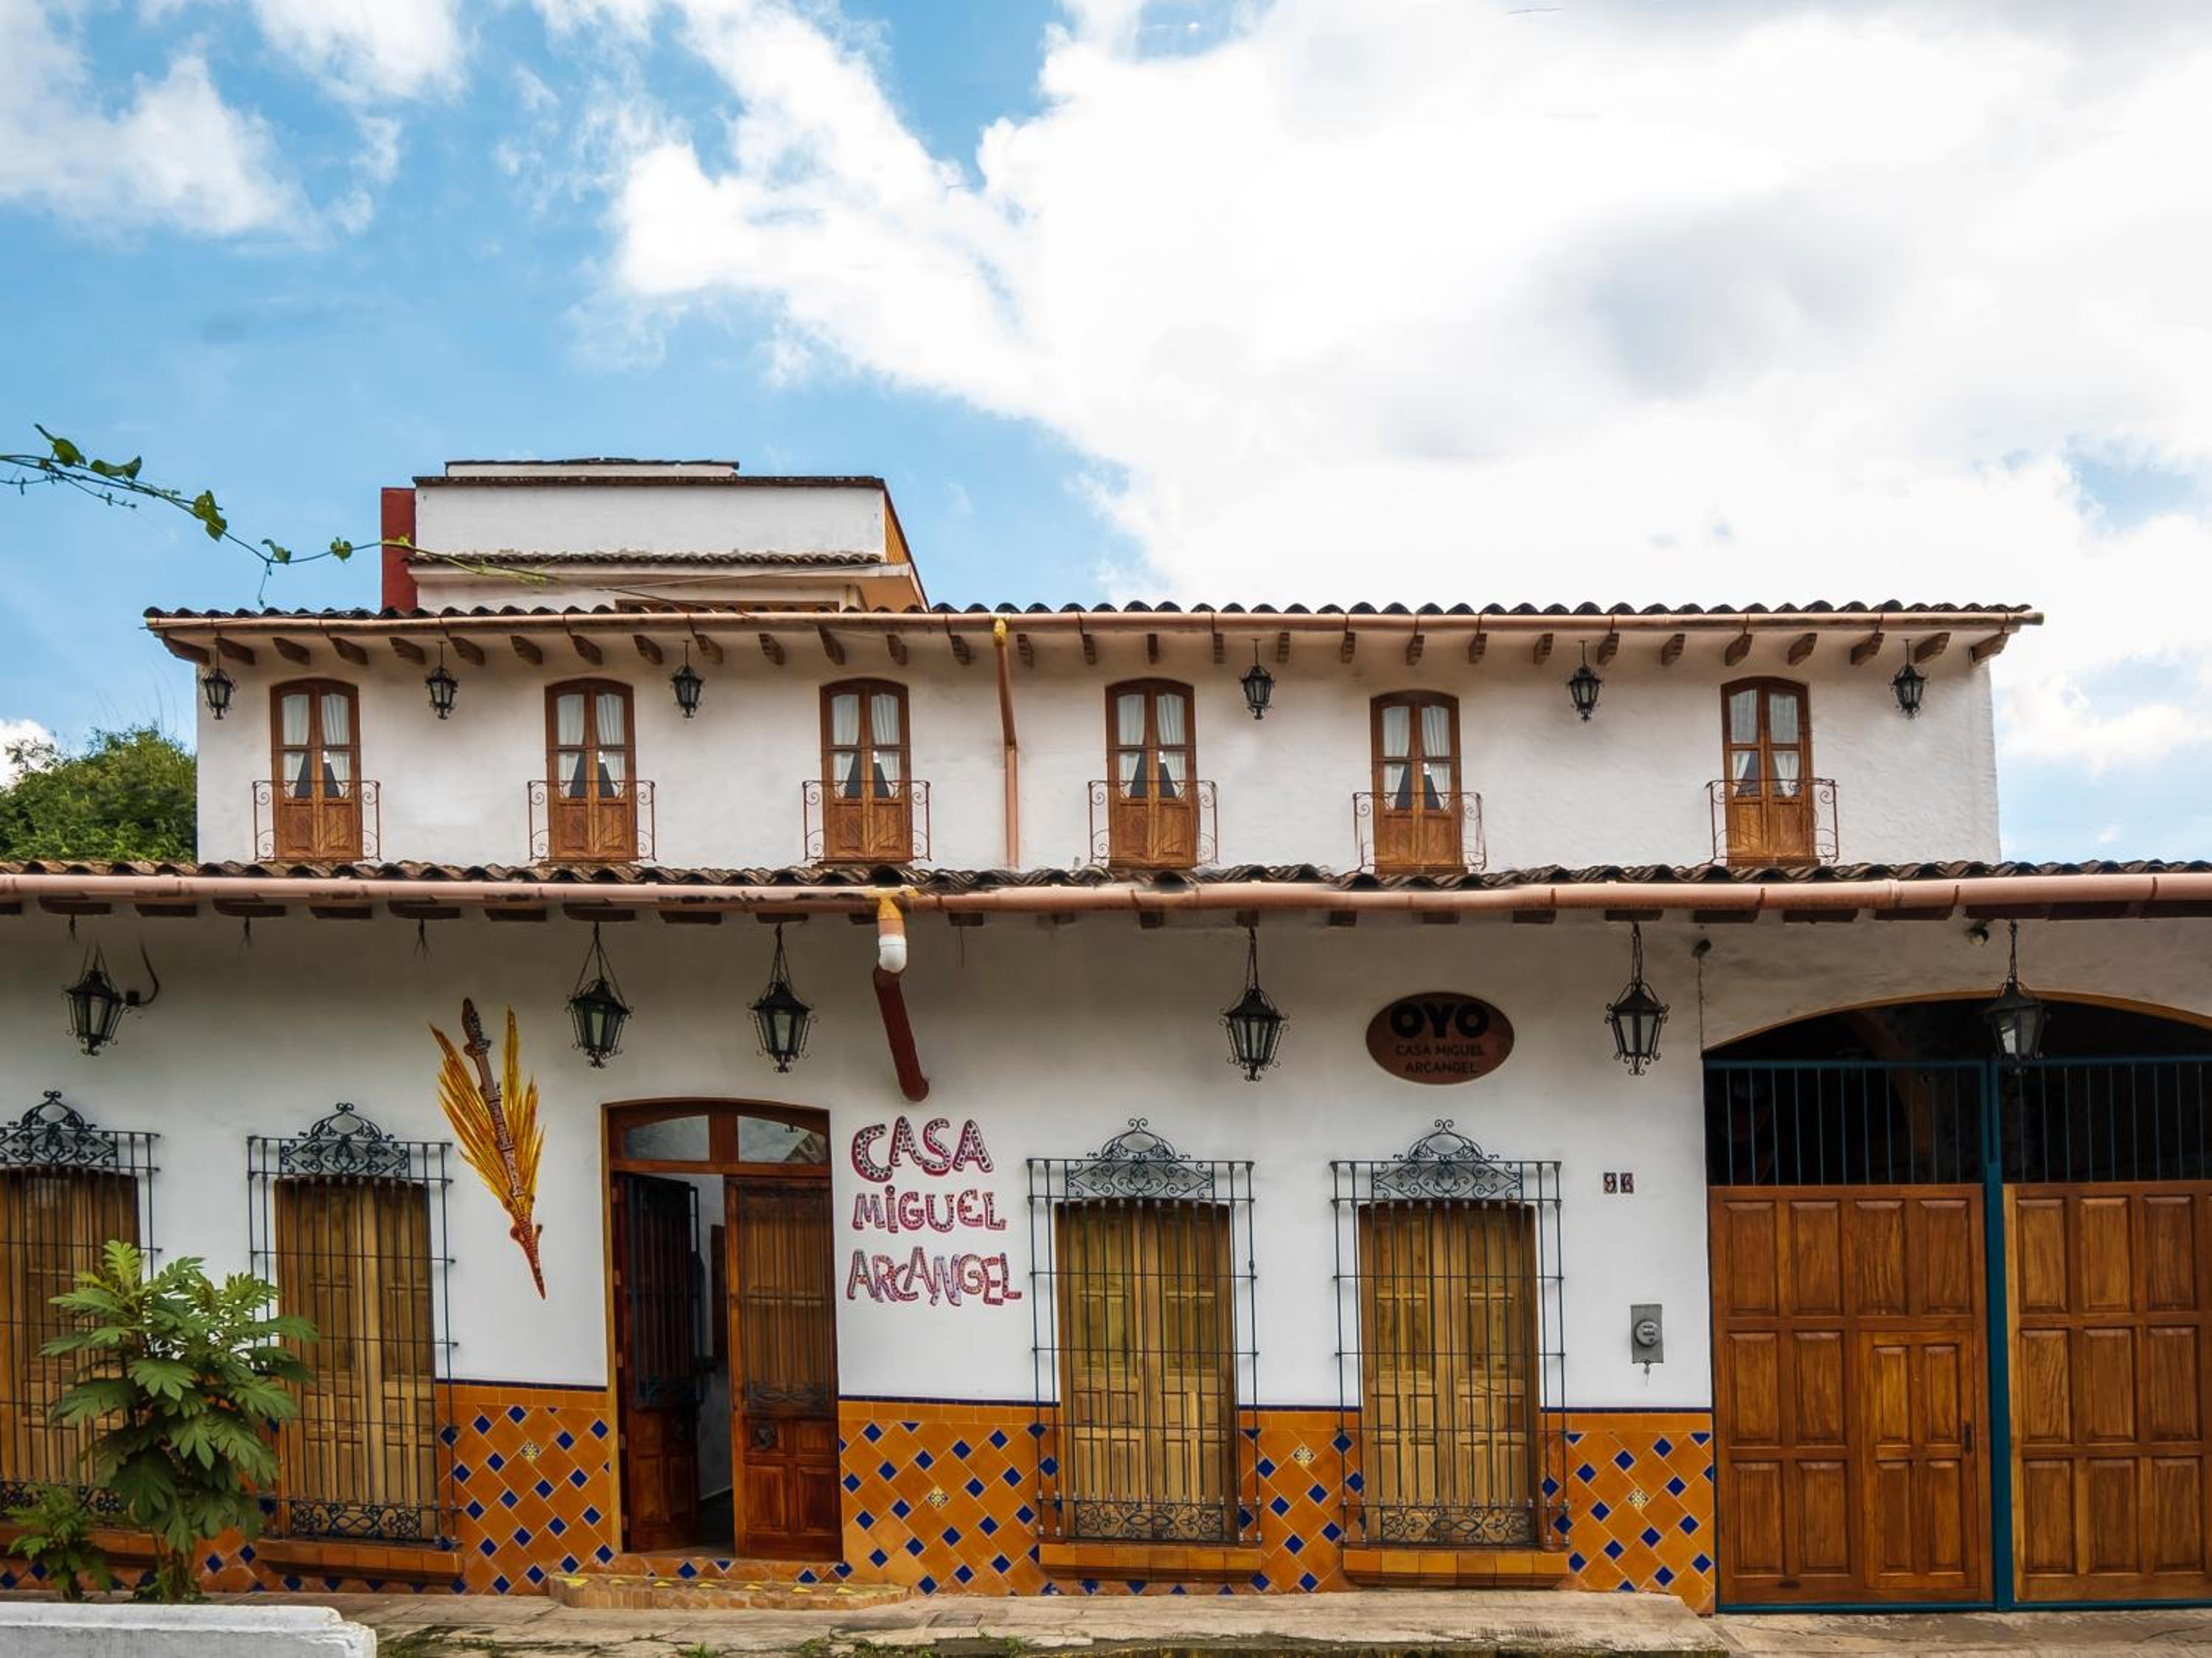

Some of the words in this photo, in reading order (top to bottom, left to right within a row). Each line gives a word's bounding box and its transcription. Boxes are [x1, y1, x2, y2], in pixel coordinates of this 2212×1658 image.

[1391, 1003, 1488, 1038] OYO
[1396, 1044, 1430, 1056] CASA
[1435, 1044, 1484, 1056] MIGUEL
[1405, 1062, 1477, 1074] ARCANGEL
[851, 1115, 994, 1182] CASA
[847, 1246, 1022, 1306] ARCANGEL
